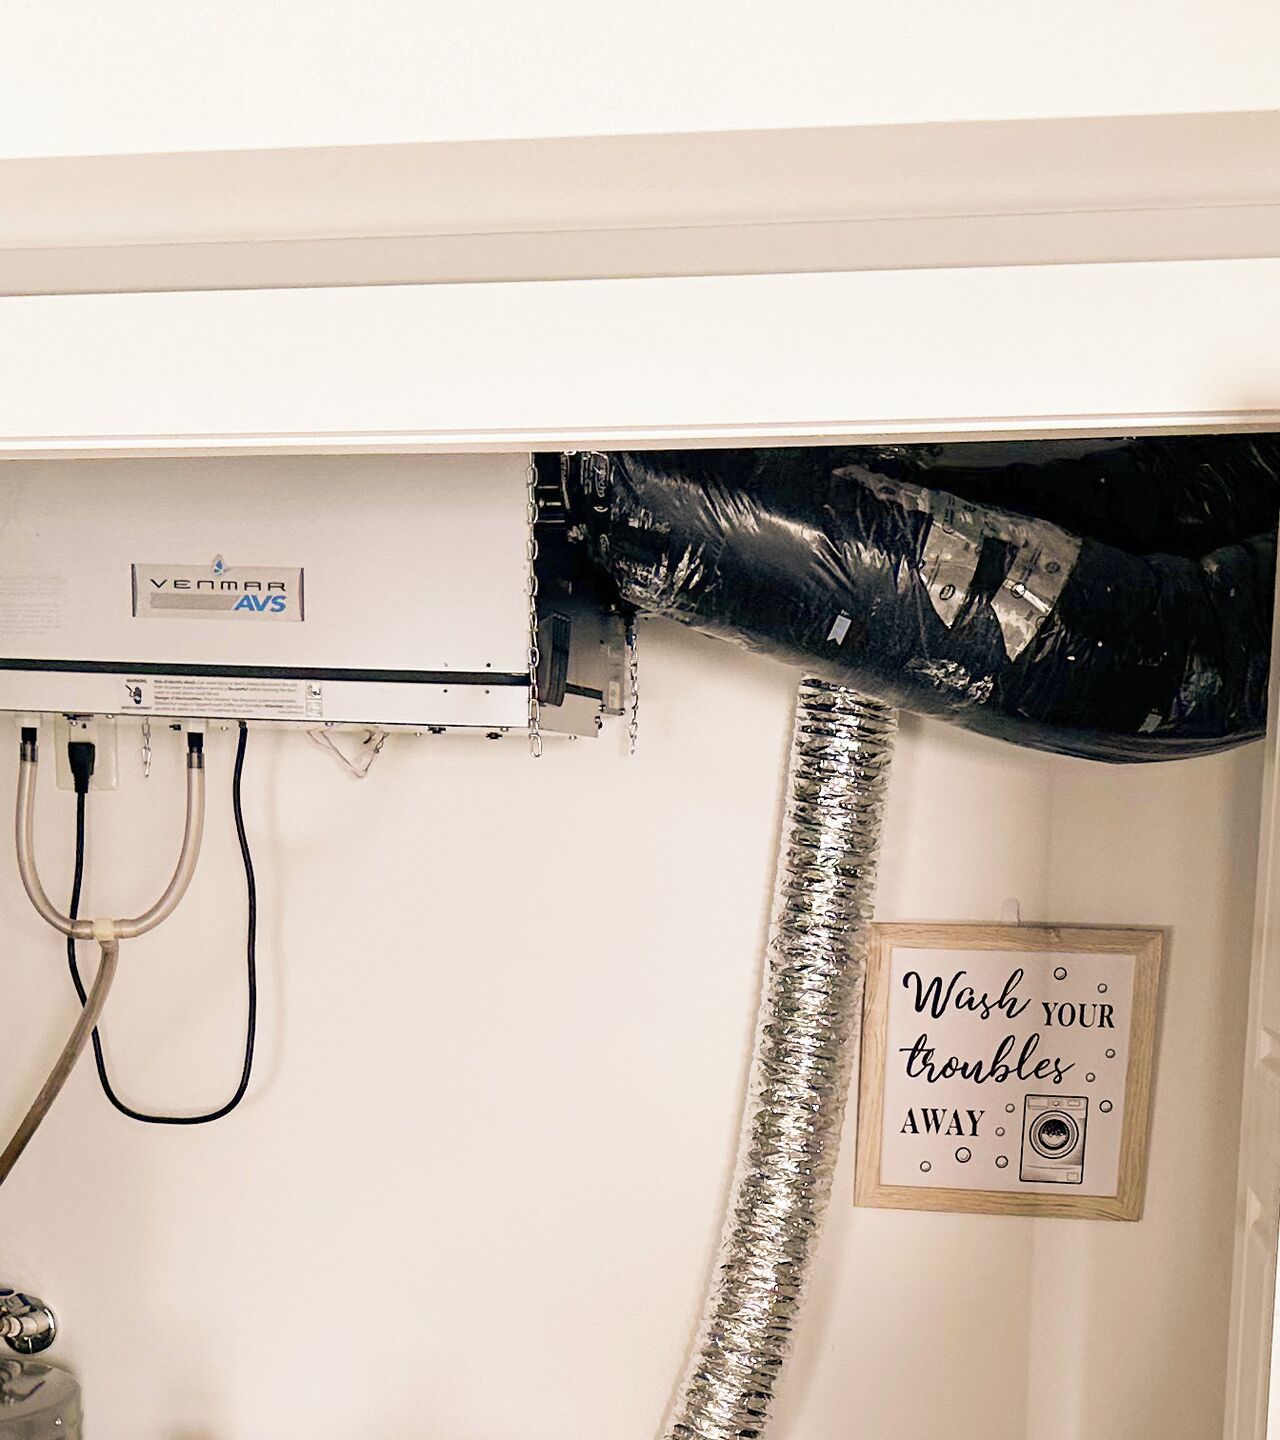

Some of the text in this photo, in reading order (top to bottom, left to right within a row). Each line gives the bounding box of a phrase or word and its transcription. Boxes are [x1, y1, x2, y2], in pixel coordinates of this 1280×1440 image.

[150, 578, 286, 592] VENMAR
[234, 594, 287, 613] AVS
[901, 967, 1115, 1029] Wash YOUR
[898, 1033, 1076, 1085] troubles
[900, 1107, 986, 1138] AWAY
